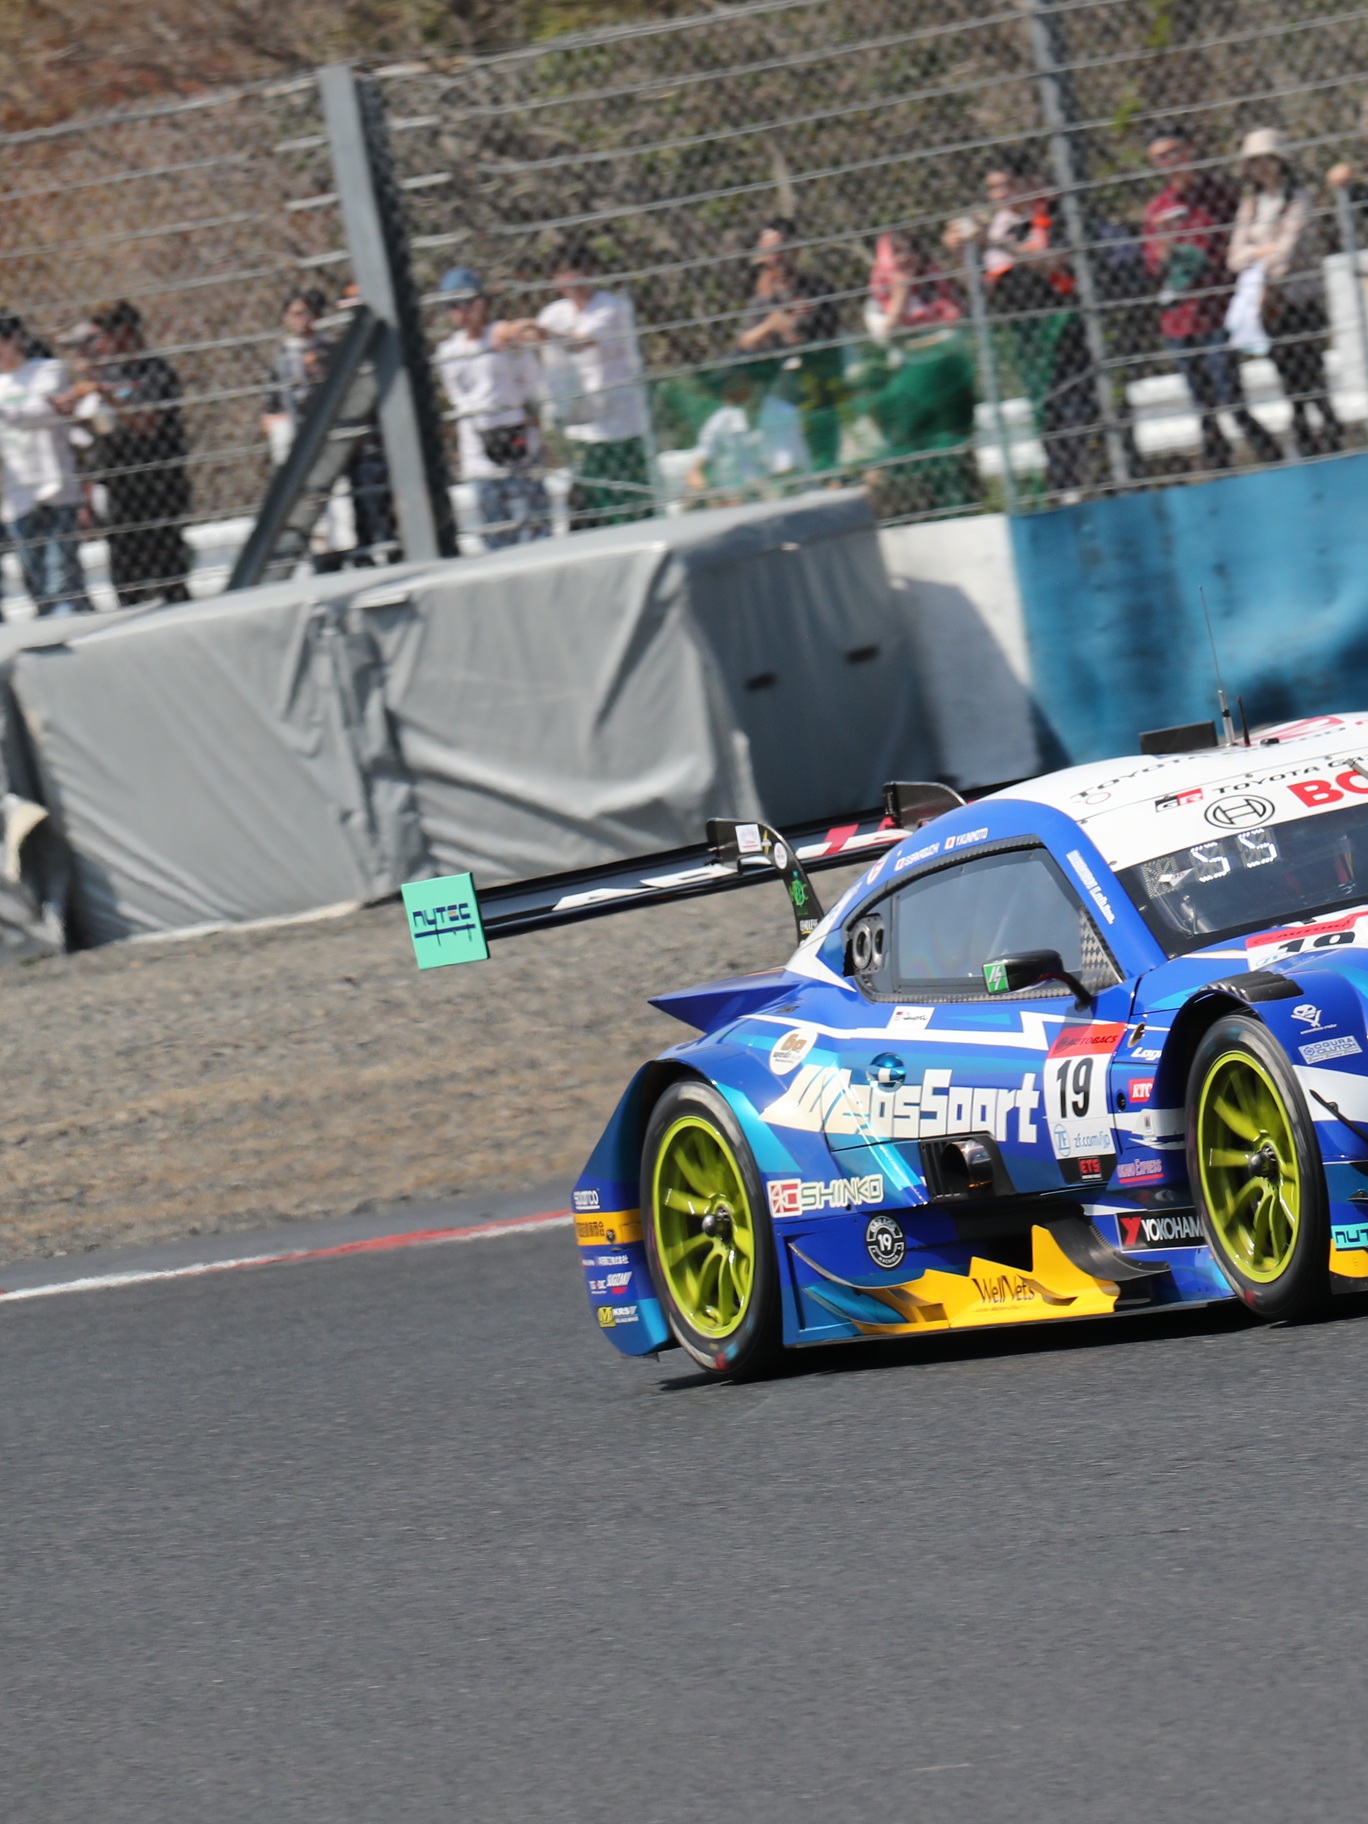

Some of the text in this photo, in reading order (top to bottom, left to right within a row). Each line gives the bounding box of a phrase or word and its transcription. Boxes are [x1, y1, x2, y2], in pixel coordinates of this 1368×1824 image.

[1212, 765, 1319, 794] TOYOTA
[1314, 1038, 1354, 1049] OGURA
[1056, 1057, 1094, 1119] 19
[1132, 1083, 1153, 1098] KTC
[1073, 1131, 1111, 1149] zf.com/jp
[800, 1174, 883, 1210] SHINKO
[1141, 1215, 1205, 1242] YOKOHAM
[878, 1233, 892, 1251] 19
